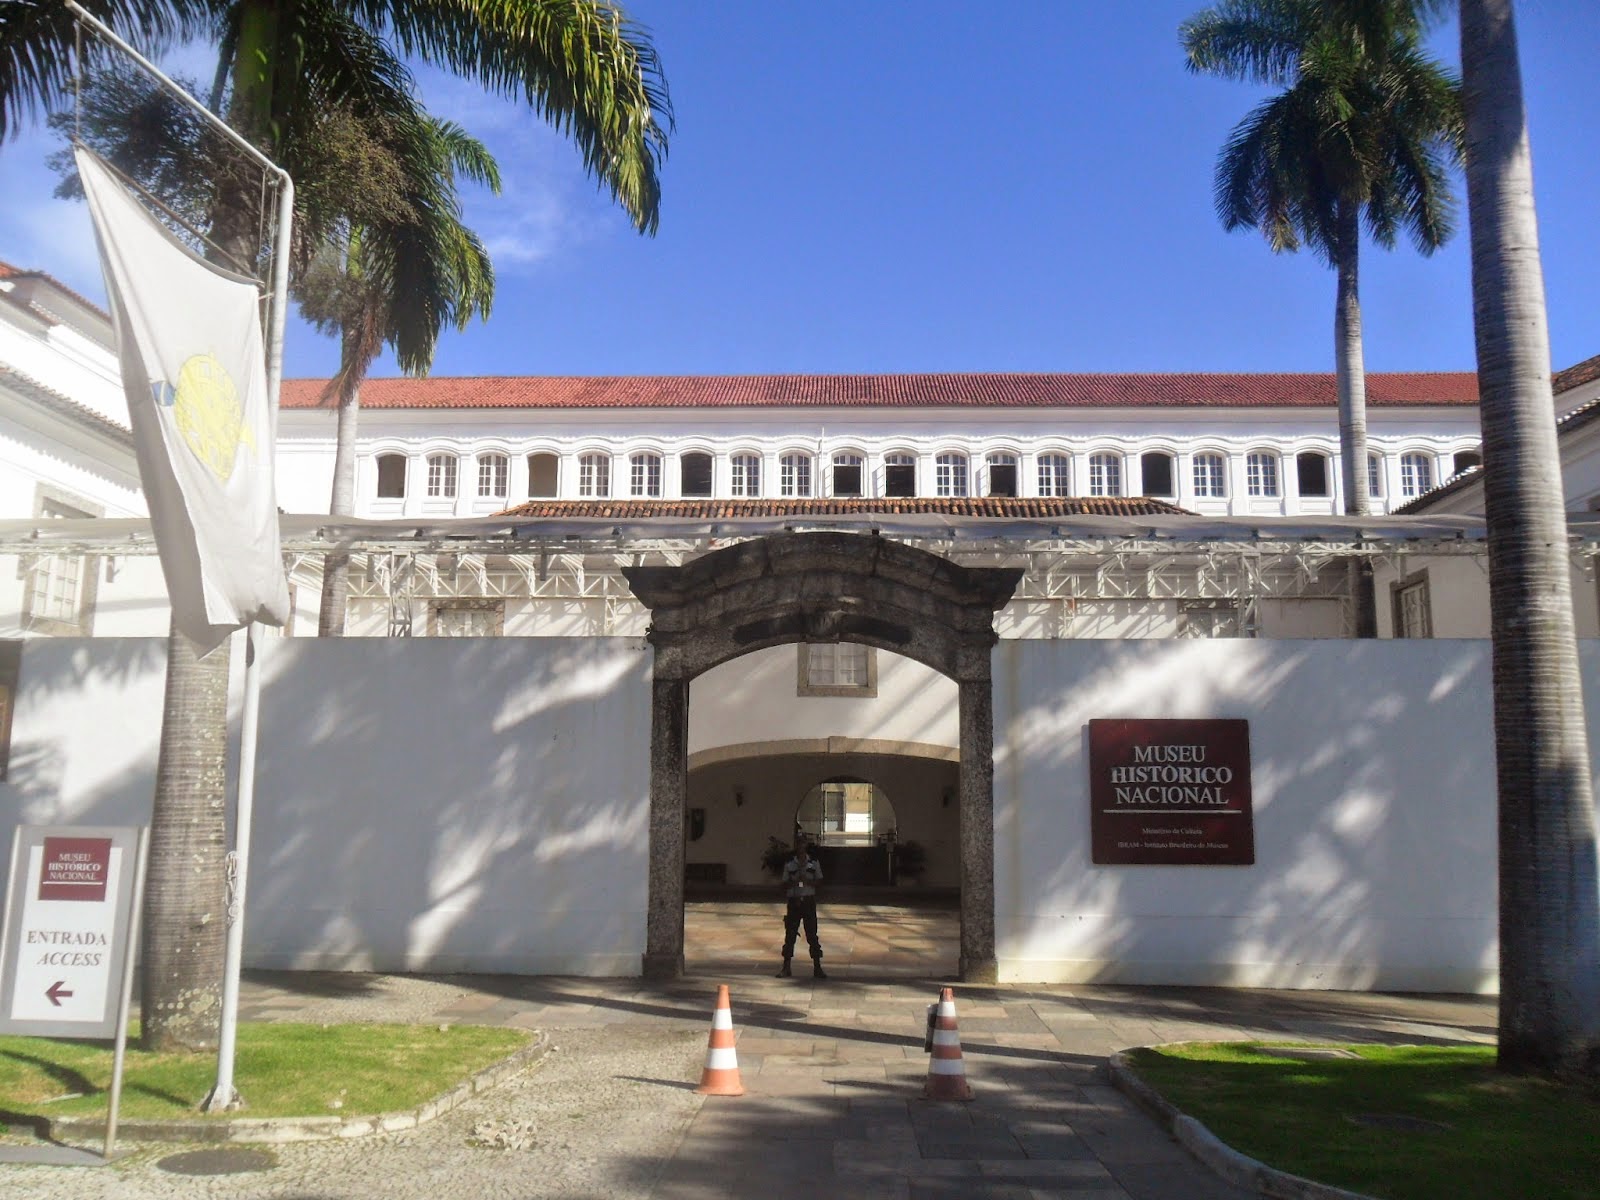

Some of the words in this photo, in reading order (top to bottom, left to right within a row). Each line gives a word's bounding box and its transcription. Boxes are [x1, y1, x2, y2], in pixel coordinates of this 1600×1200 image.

[1133, 745, 1206, 763] MUSEU
[1115, 786, 1229, 804] NACIONAL
[59, 853, 91, 862] MUSEU
[48, 861, 101, 871] HISTÓRICO
[49, 871, 97, 880] NACIONAL
[26, 930, 107, 946] ENTRADA
[36, 952, 102, 966] ACCESS
